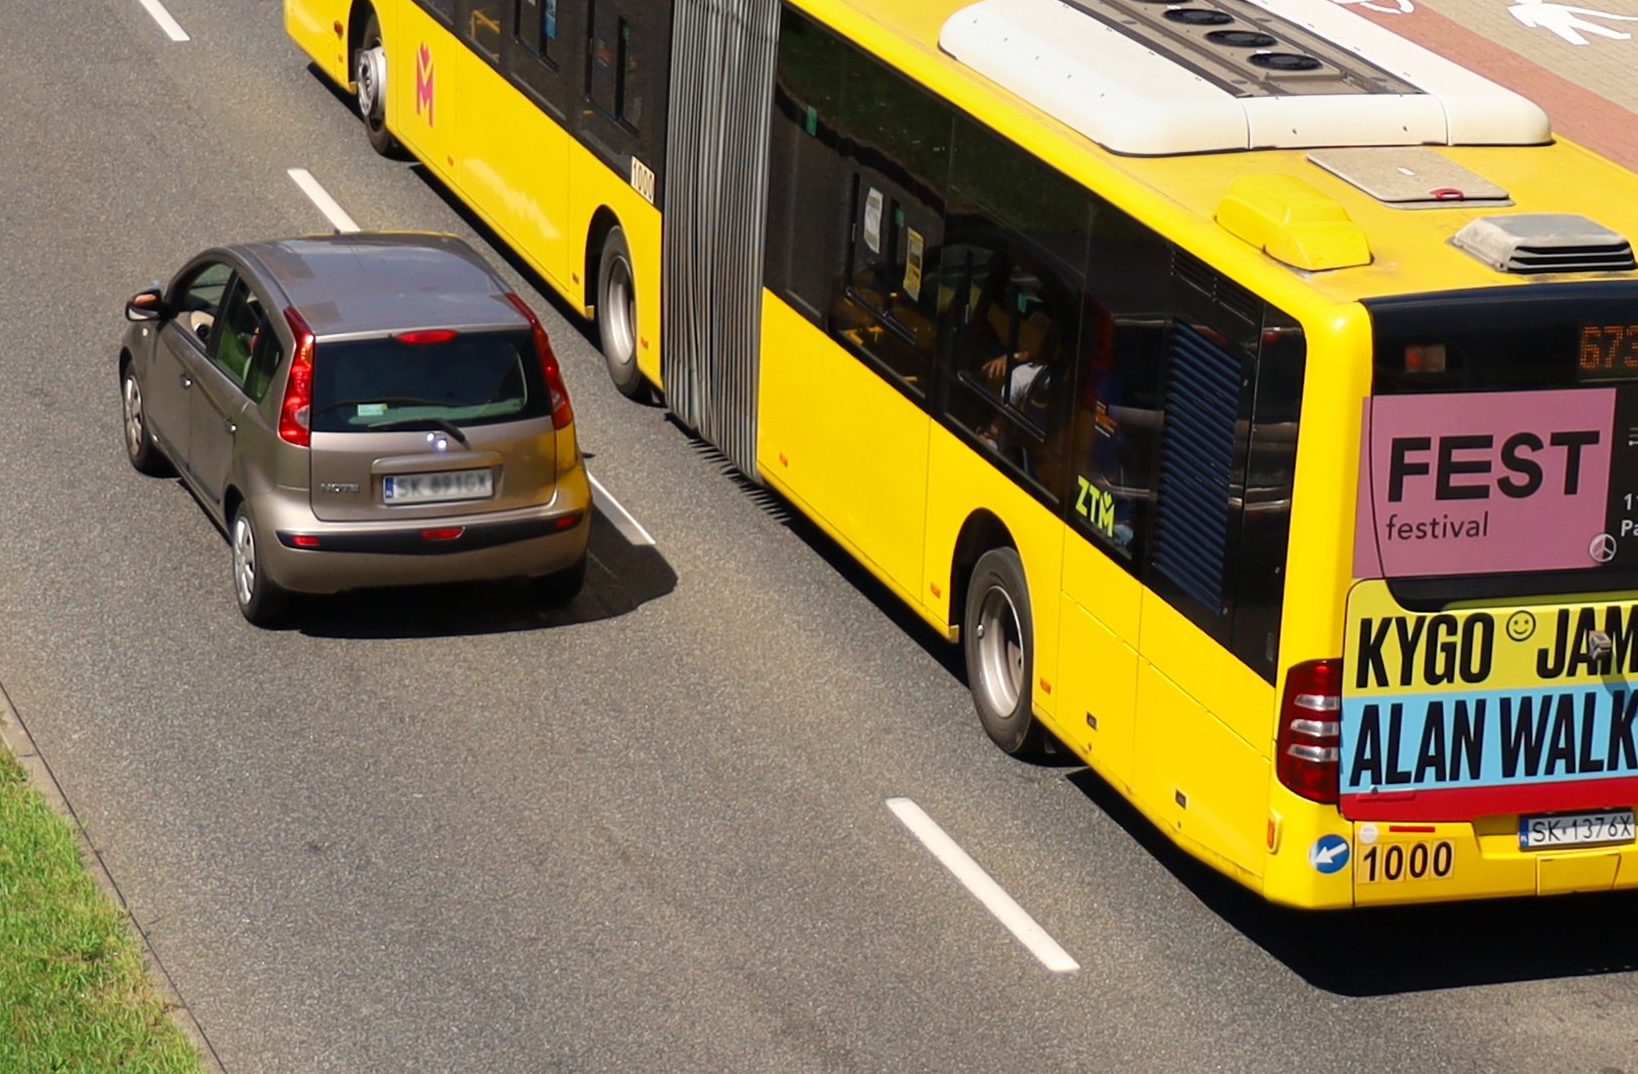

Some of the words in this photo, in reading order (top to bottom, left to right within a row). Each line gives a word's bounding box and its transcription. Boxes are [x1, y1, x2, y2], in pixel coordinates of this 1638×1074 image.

[633, 161, 653, 201] 1000
[1387, 430, 1600, 503] FEST
[399, 477, 422, 497] SK
[1385, 511, 1489, 541] festival
[1355, 611, 1495, 689] KYGO
[1349, 697, 1487, 787] ALAN
[1533, 820, 1561, 843] SK
[1571, 815, 1632, 840] 1376X
[1363, 841, 1452, 882] 1000
